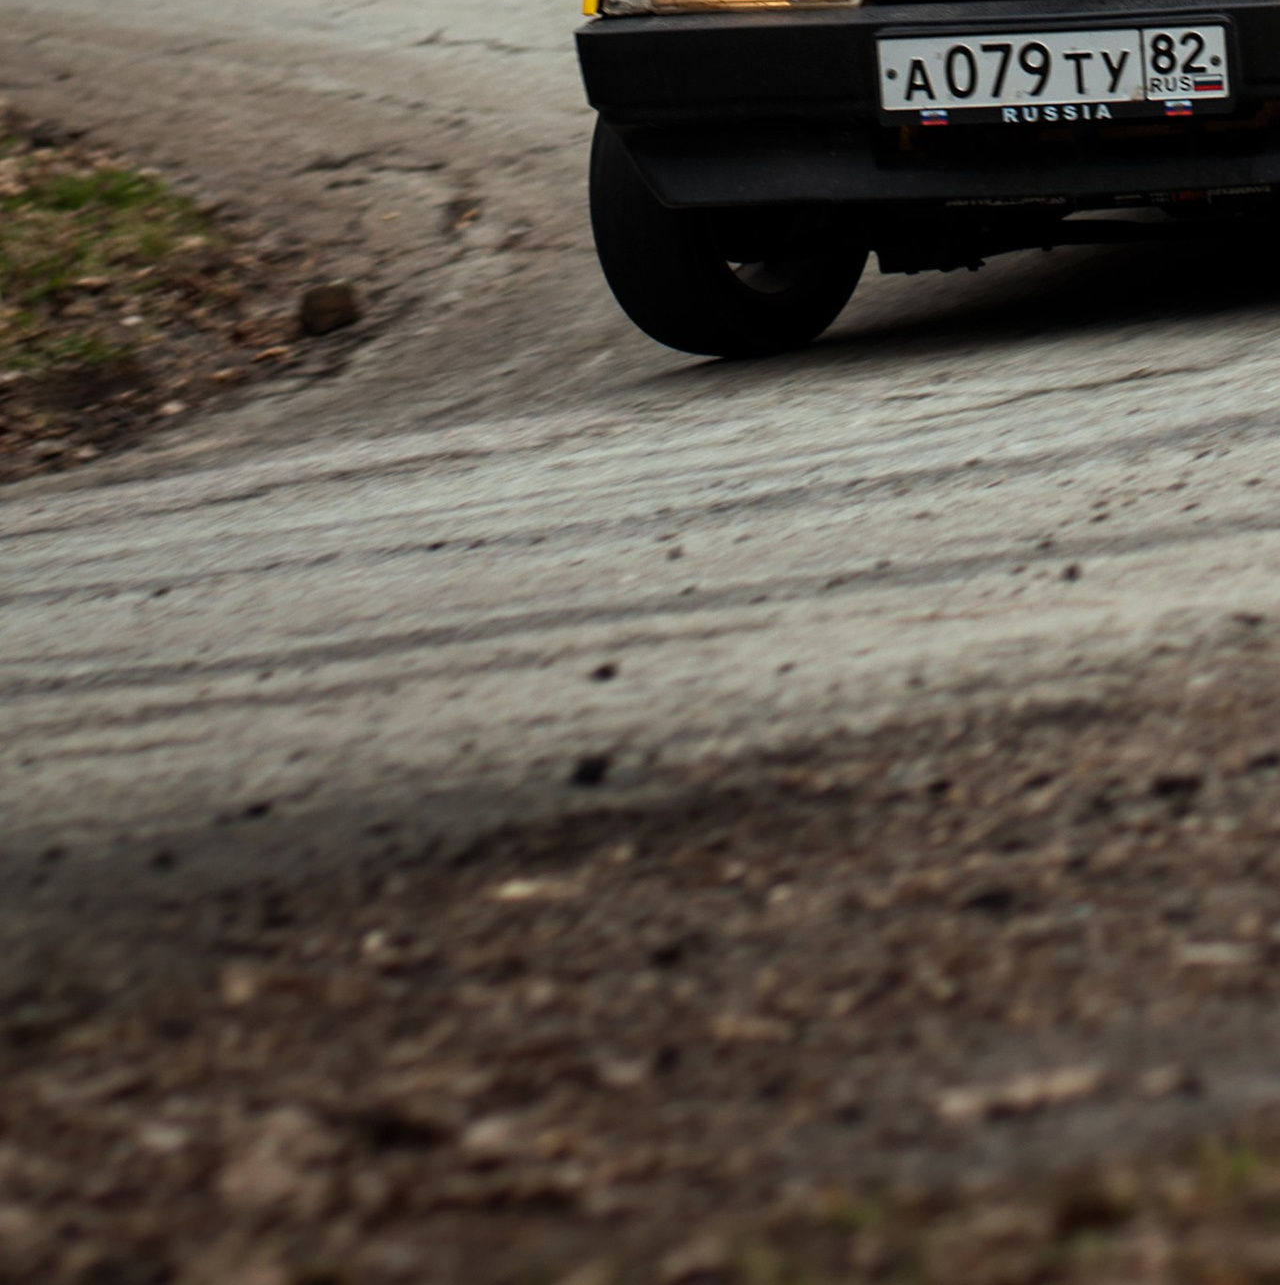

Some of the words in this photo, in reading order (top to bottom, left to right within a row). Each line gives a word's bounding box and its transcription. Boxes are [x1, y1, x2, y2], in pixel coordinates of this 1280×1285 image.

[1150, 31, 1207, 75] 82
[1150, 76, 1192, 93] RUS
[1002, 102, 1113, 123] RUSSIA
